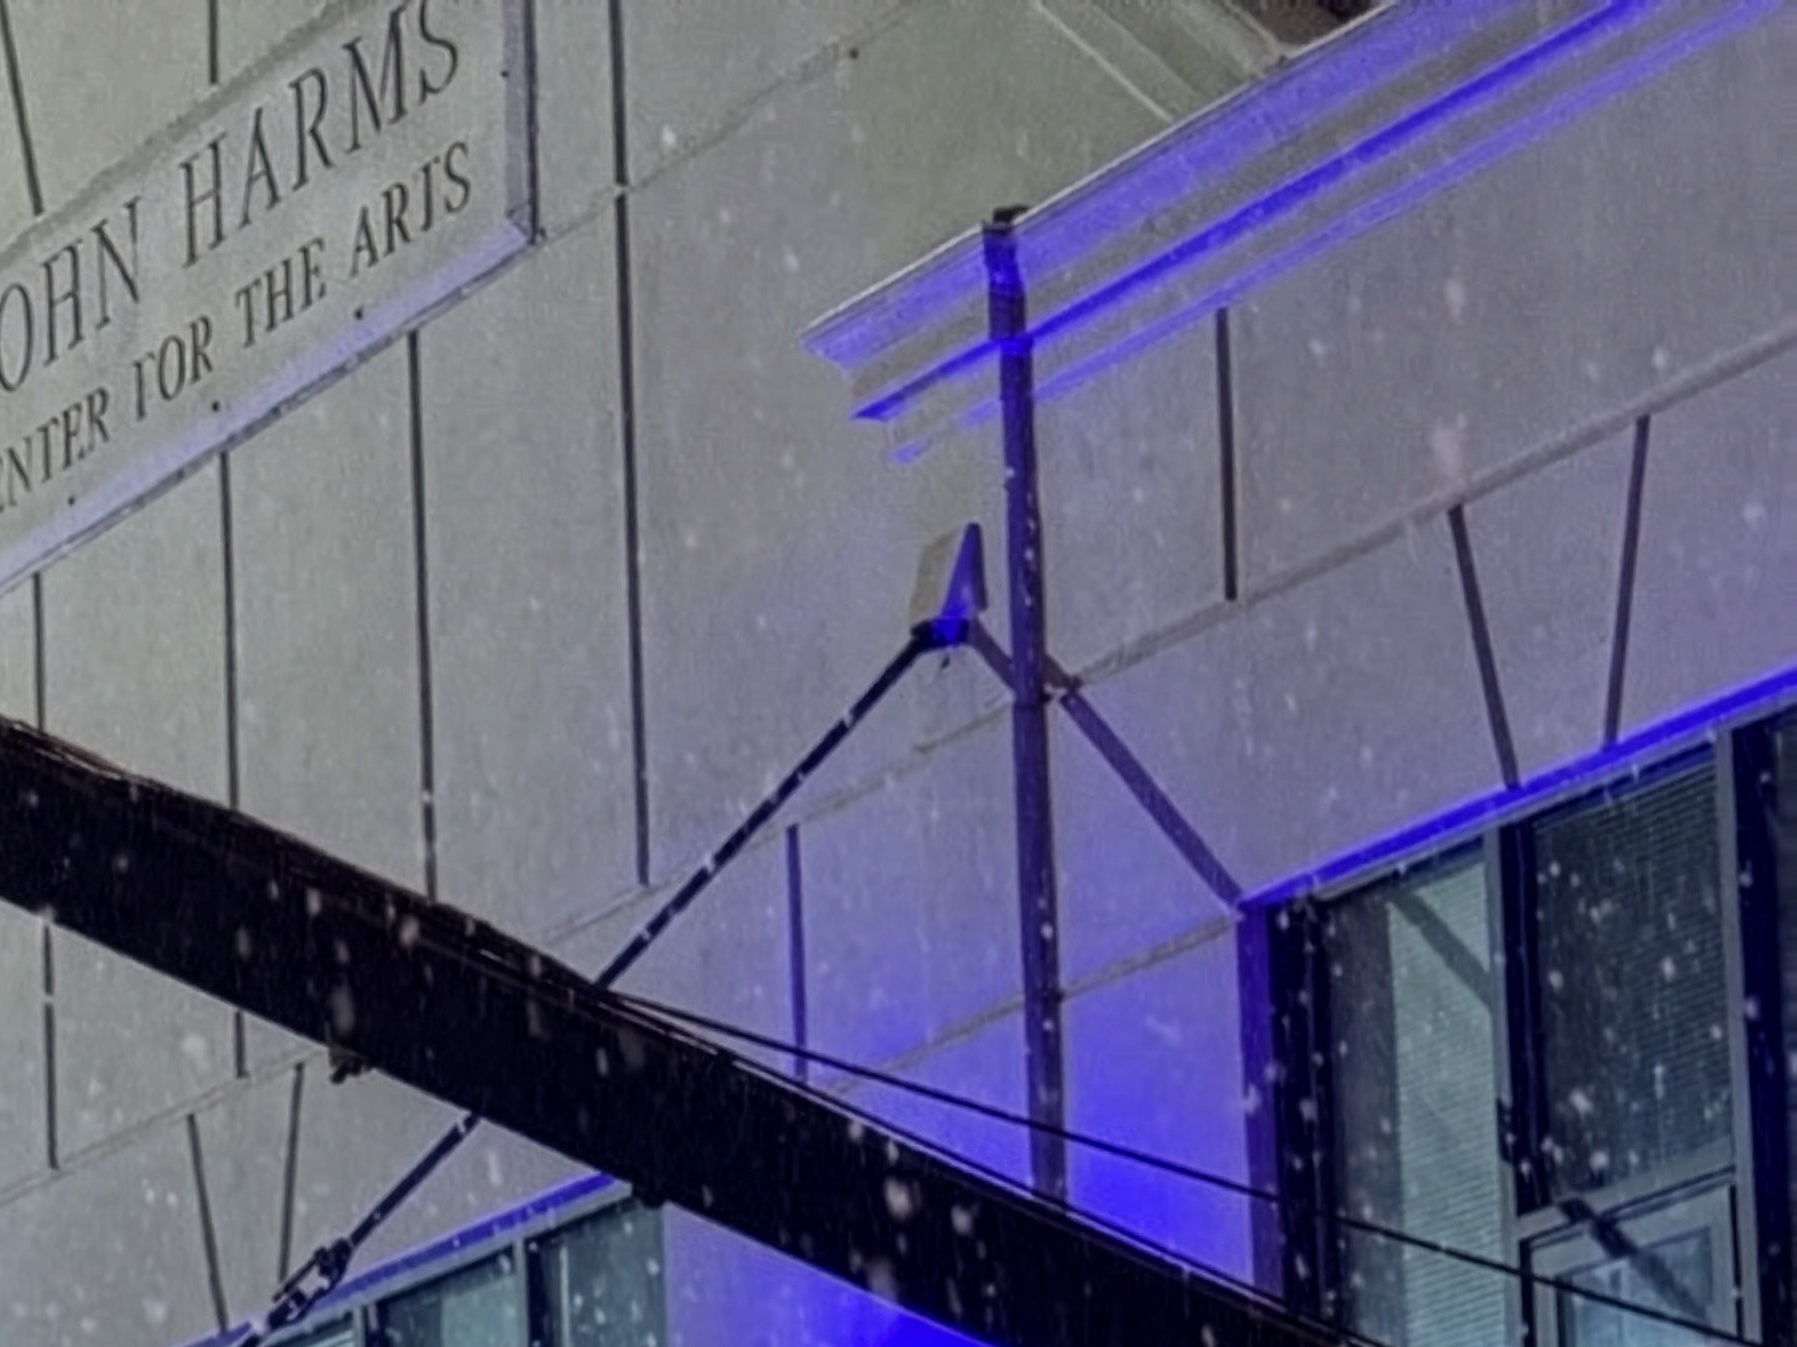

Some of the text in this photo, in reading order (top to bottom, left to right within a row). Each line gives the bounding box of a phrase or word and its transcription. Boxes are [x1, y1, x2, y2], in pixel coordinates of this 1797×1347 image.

[180, 0, 459, 269] HARMS
[132, 315, 214, 422] FOR
[234, 238, 327, 348] THE
[348, 141, 473, 279] ARTS
